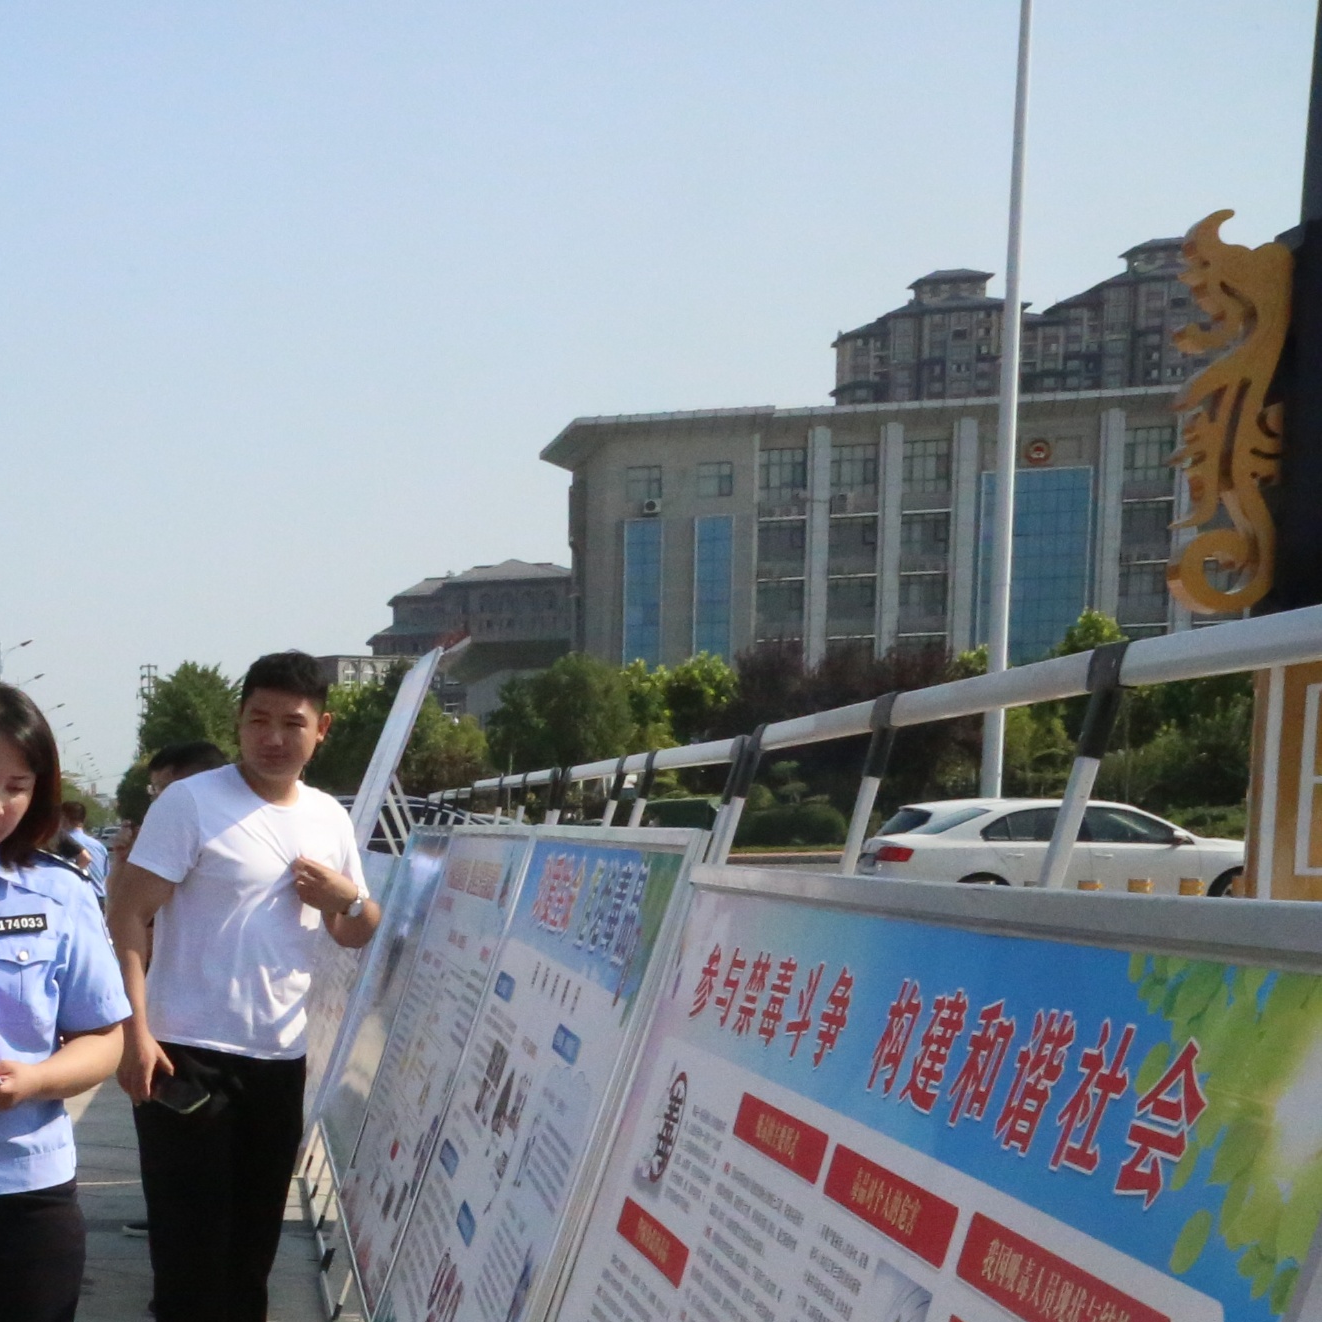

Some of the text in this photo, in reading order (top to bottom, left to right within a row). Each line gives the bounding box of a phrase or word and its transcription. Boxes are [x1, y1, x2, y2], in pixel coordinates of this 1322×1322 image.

[689, 943, 854, 1069] 参与禁毒斗争
[866, 977, 1207, 1210] 构建和谐社会
[850, 1166, 922, 1237] 毒品对个人的危害
